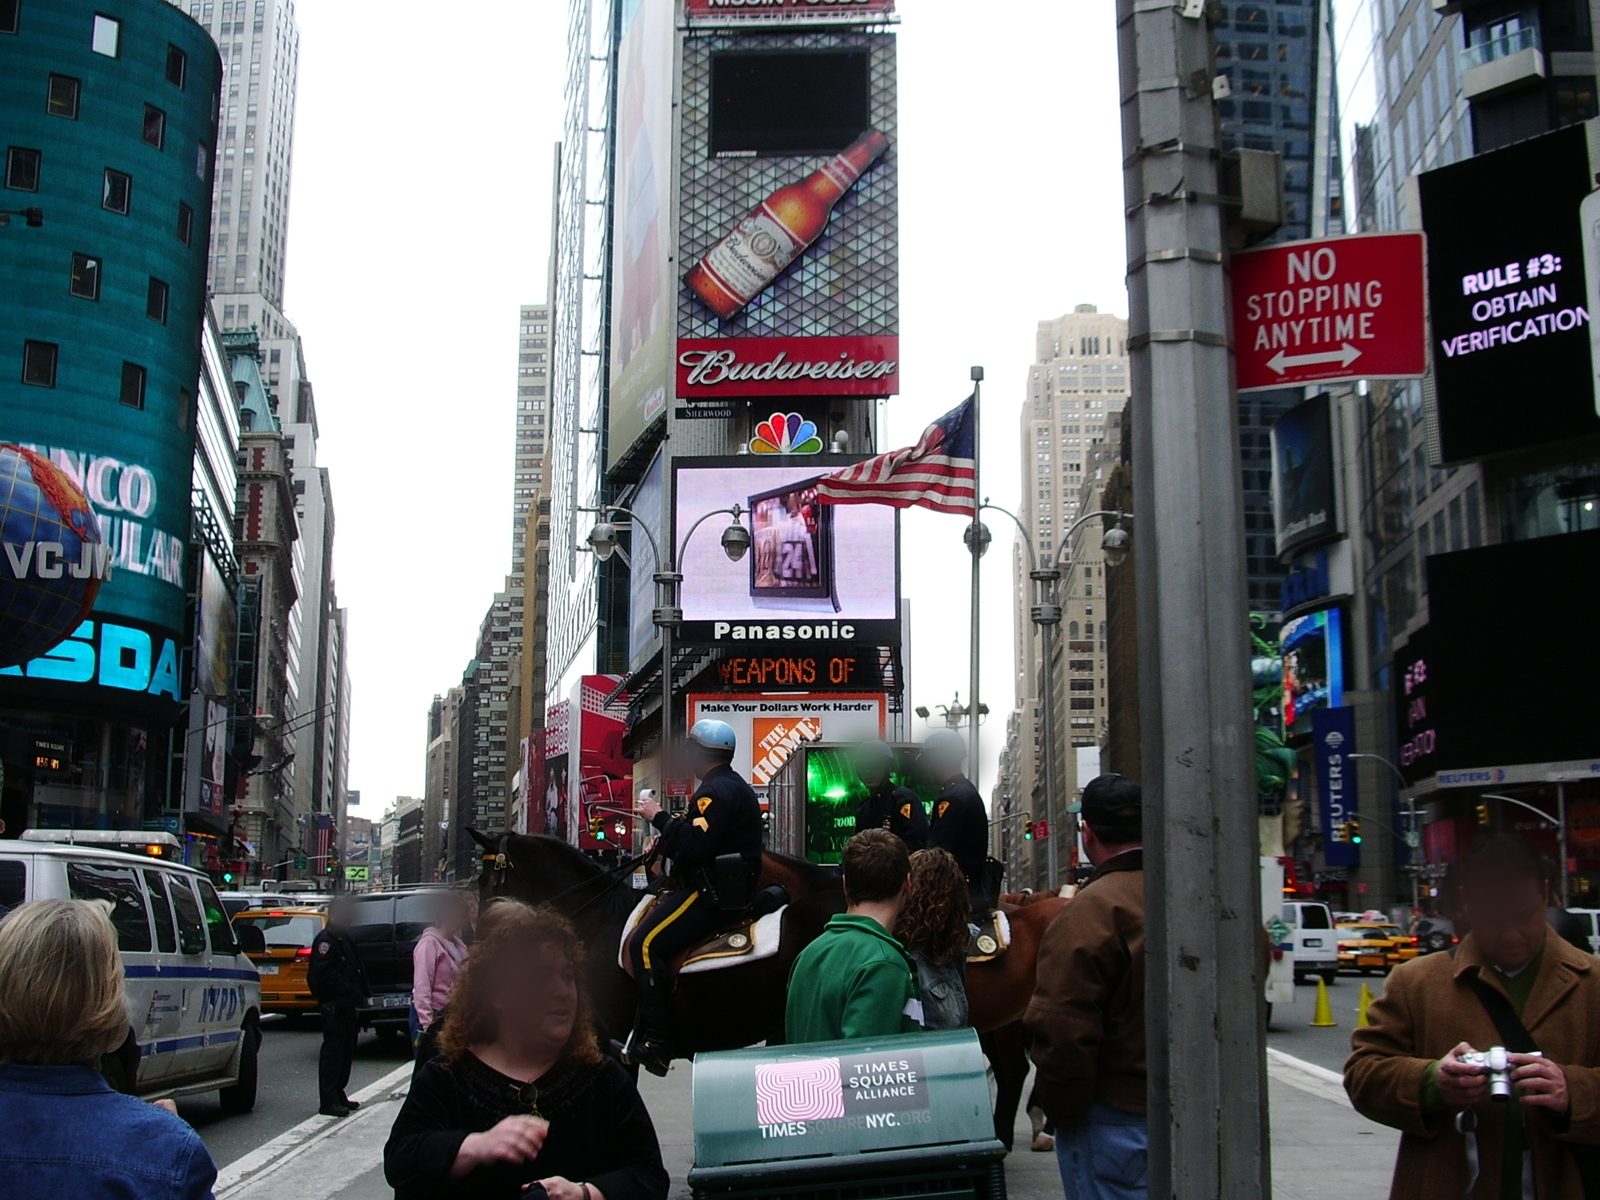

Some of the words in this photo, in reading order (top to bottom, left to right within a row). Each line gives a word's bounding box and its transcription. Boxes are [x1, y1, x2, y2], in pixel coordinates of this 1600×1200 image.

[1287, 248, 1337, 284] NO
[1462, 262, 1522, 297] RULE
[1526, 254, 1562, 279] #3:
[1246, 280, 1383, 322] STOPPING
[1471, 283, 1557, 322] OBTAIN
[1254, 312, 1375, 352] ANYTIME
[1441, 306, 1591, 358] VERIFICATION
[679, 349, 896, 386] Budweiser
[714, 621, 855, 640] Panasonic
[831, 658, 856, 683] OF
[701, 703, 731, 713] Make
[732, 703, 759, 713] Your
[760, 702, 799, 713] Dollars
[800, 702, 831, 712] Work
[833, 702, 873, 712] Harder
[752, 717, 821, 786] HOME
[759, 723, 788, 751] THE
[1438, 772, 1491, 784] REUTERS
[1327, 753, 1345, 843] REUTERS
[197, 988, 238, 1023] NYPD
[849, 1072, 918, 1089] SQUARE
[853, 1060, 909, 1074] TIMES
[855, 1086, 916, 1101] ALLIANCE
